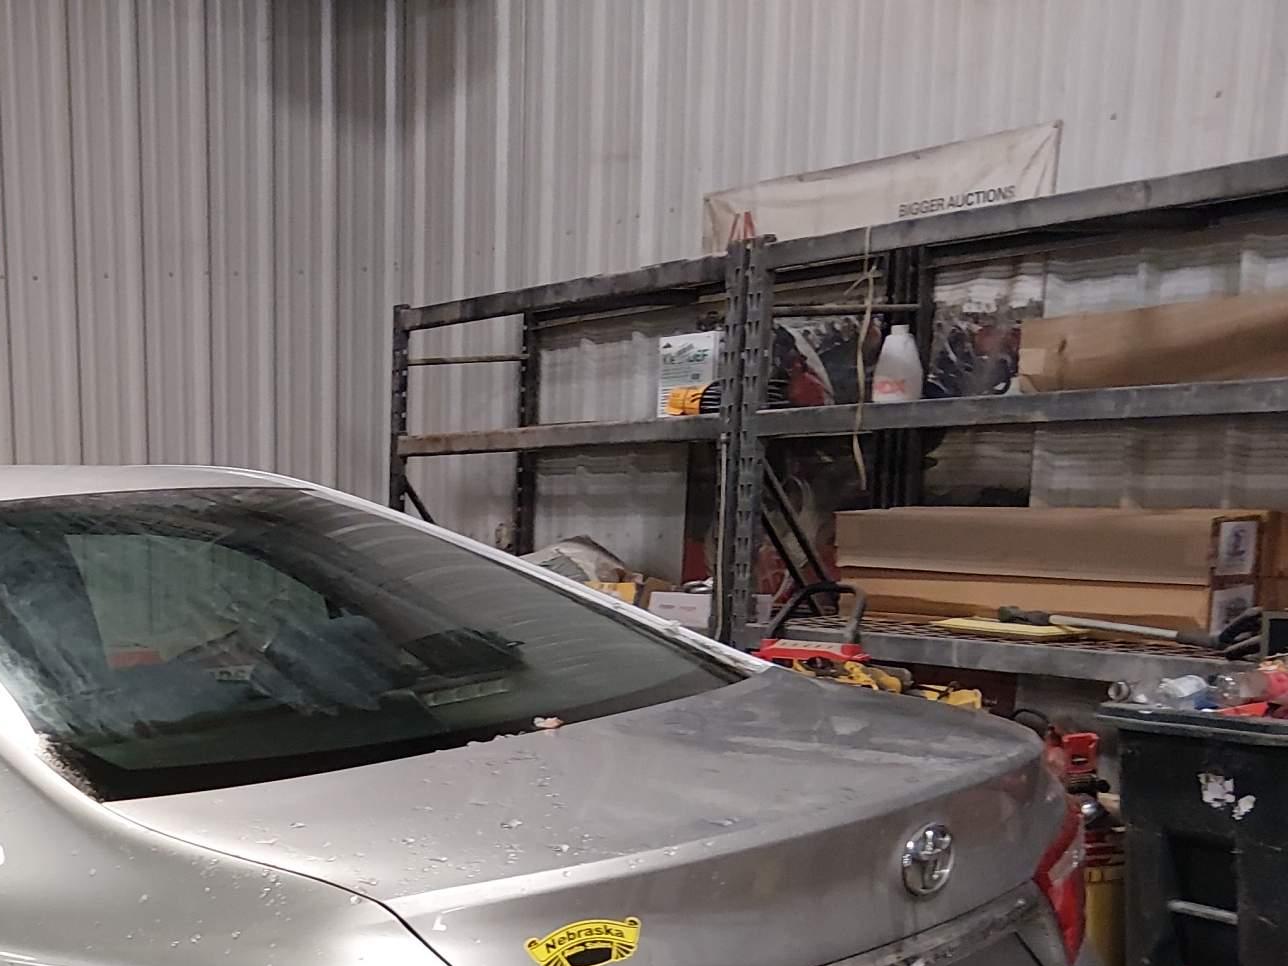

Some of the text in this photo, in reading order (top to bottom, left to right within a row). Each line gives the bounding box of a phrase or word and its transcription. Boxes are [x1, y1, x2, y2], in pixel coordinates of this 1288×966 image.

[898, 185, 1015, 217] BIGGER AUCTIONS
[545, 924, 625, 953] Nebraska
